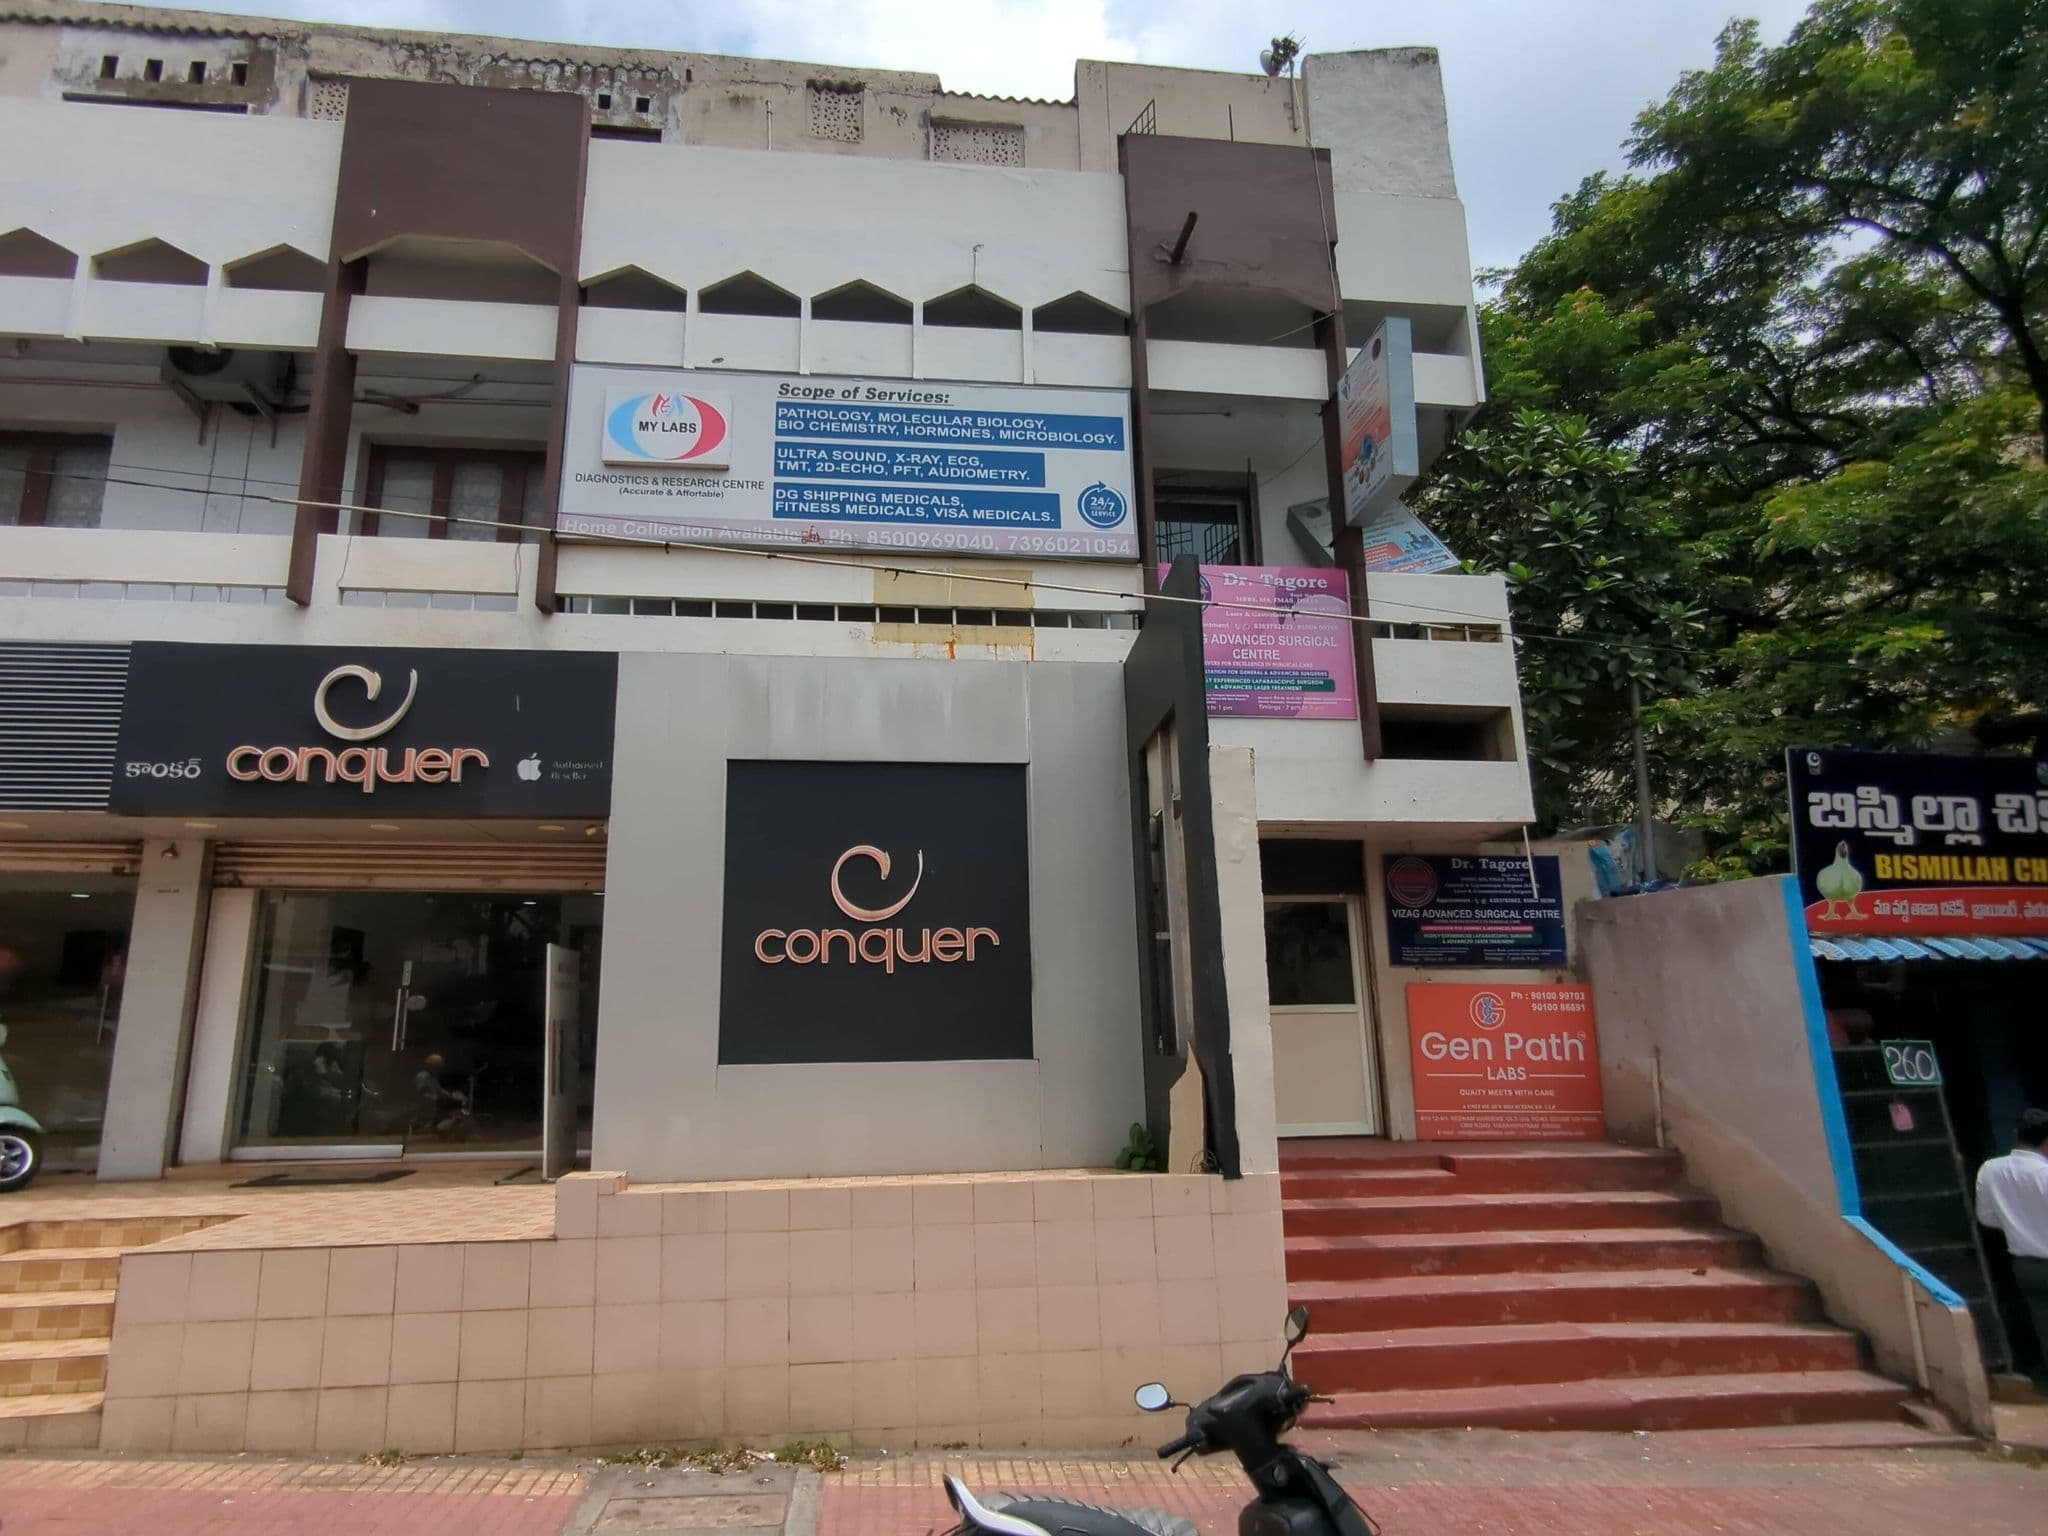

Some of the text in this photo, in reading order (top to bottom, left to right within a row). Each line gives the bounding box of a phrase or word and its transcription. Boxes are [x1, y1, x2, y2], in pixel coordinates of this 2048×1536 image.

[777, 383, 950, 404] Scope of Services:
[638, 421, 697, 434] MY LABS
[778, 408, 1047, 430] PATHOLOGY, MOLECULAR BIOLOGY,
[778, 420, 1117, 445] BIO CHEMISTRY, HORMONES, MICROBIOLOGY.
[777, 448, 983, 468] ULTRA SOUND, X-RAY, ECG,
[777, 461, 1031, 481] TMT, 2D-ECHO, PFT, AUDIOMETRY.
[575, 473, 765, 490] DIAGNOSTICS & RESEARCH CENTRE
[619, 488, 664, 497] (Accurate
[666, 489, 673, 497] &
[776, 489, 964, 508] DG SHIPPING MEDICALS,
[775, 502, 1055, 523] FITNESS MEDICALS, VISA MEDICALS.
[1090, 497, 1115, 511] 24/7
[565, 520, 616, 535] Home
[623, 522, 713, 538] Collection
[1008, 536, 1130, 555] 7396021054
[1223, 573, 1328, 591] Dr. Tagore
[1211, 634, 1275, 646] ADVANCED
[1279, 635, 1337, 647] SURGICAL
[1233, 648, 1280, 660] CENTRE
[226, 745, 489, 793] conquer
[1451, 858, 1531, 872] Dr. Tagore
[1874, 854, 2009, 881] BISMILLAH
[1392, 909, 1560, 919] VIZAG ADVANCED SURGICAL CENTRE
[754, 927, 1000, 974] conquer
[1421, 1032, 1585, 1061] Gen Path
[1885, 1046, 1936, 1081] 260
[1487, 1067, 1526, 1081] LABS
